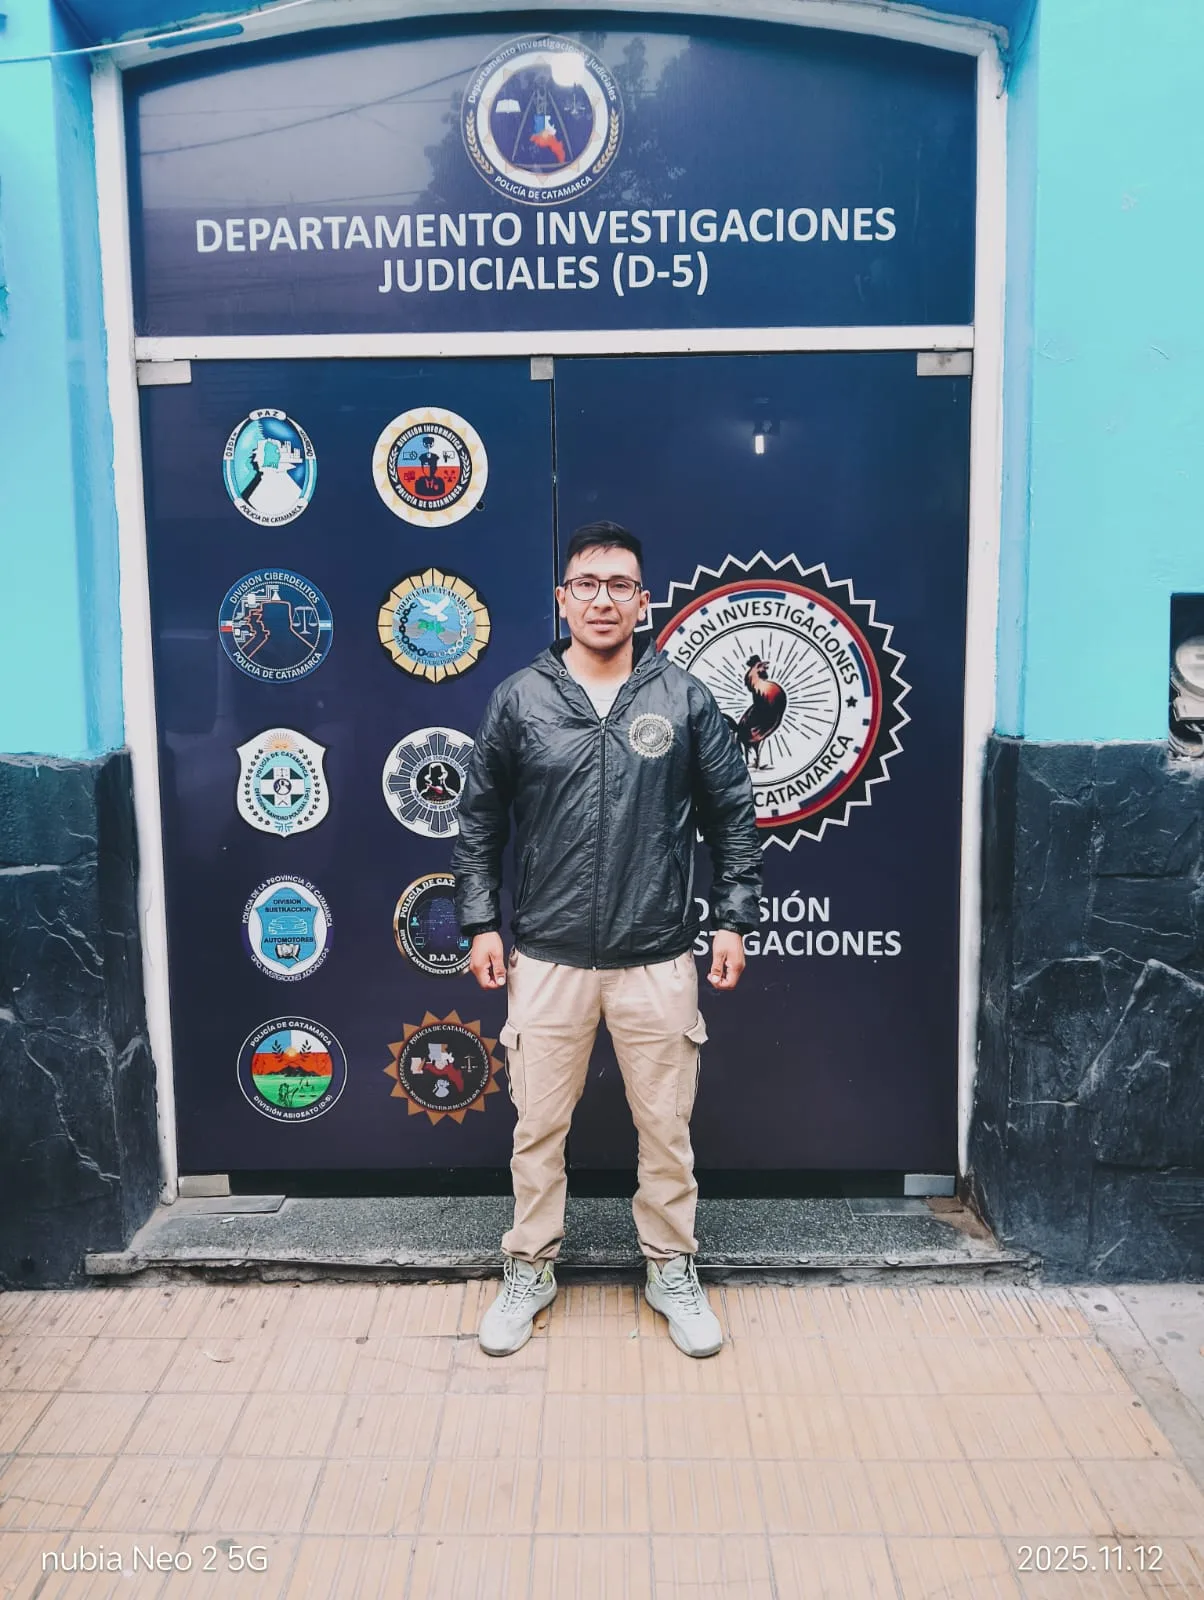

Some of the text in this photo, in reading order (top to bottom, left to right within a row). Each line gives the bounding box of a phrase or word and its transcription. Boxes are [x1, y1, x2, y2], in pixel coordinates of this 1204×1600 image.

[468, 46, 517, 104] Departamento
[586, 56, 617, 101] Judiciales
[494, 175, 592, 200] POLICÍA DE CATAMARCA
[195, 207, 897, 253] DEPARTAMENTO INVESTIGACIONES
[378, 250, 709, 296] JUDICIALES (D-5)
[428, 486, 462, 508] CATAMARCA
[230, 572, 320, 604] DIVISION CIBERDELITOS
[720, 601, 859, 686] INVESTIGACIONES
[233, 651, 322, 680] POLICIA DE CATAMARCA
[281, 751, 309, 778] CATAMARCA
[754, 734, 854, 808] CATAMARCA
[242, 899, 254, 924] POLICIA
[251, 890, 260, 898] DE
[266, 874, 304, 885] PROVINCIA
[306, 882, 314, 890] DE
[314, 890, 332, 927] CATAMARCA
[400, 885, 422, 918] POLICÍA
[422, 879, 435, 889] DE
[694, 890, 830, 922] DSIÓN
[429, 954, 458, 962] D.A.P.
[250, 1025, 276, 1048] POLICÍA
[288, 1020, 332, 1046] CATAMARCA
[442, 1024, 478, 1044] CATAMARCA
[254, 1095, 282, 1117] DIVISIÓN
